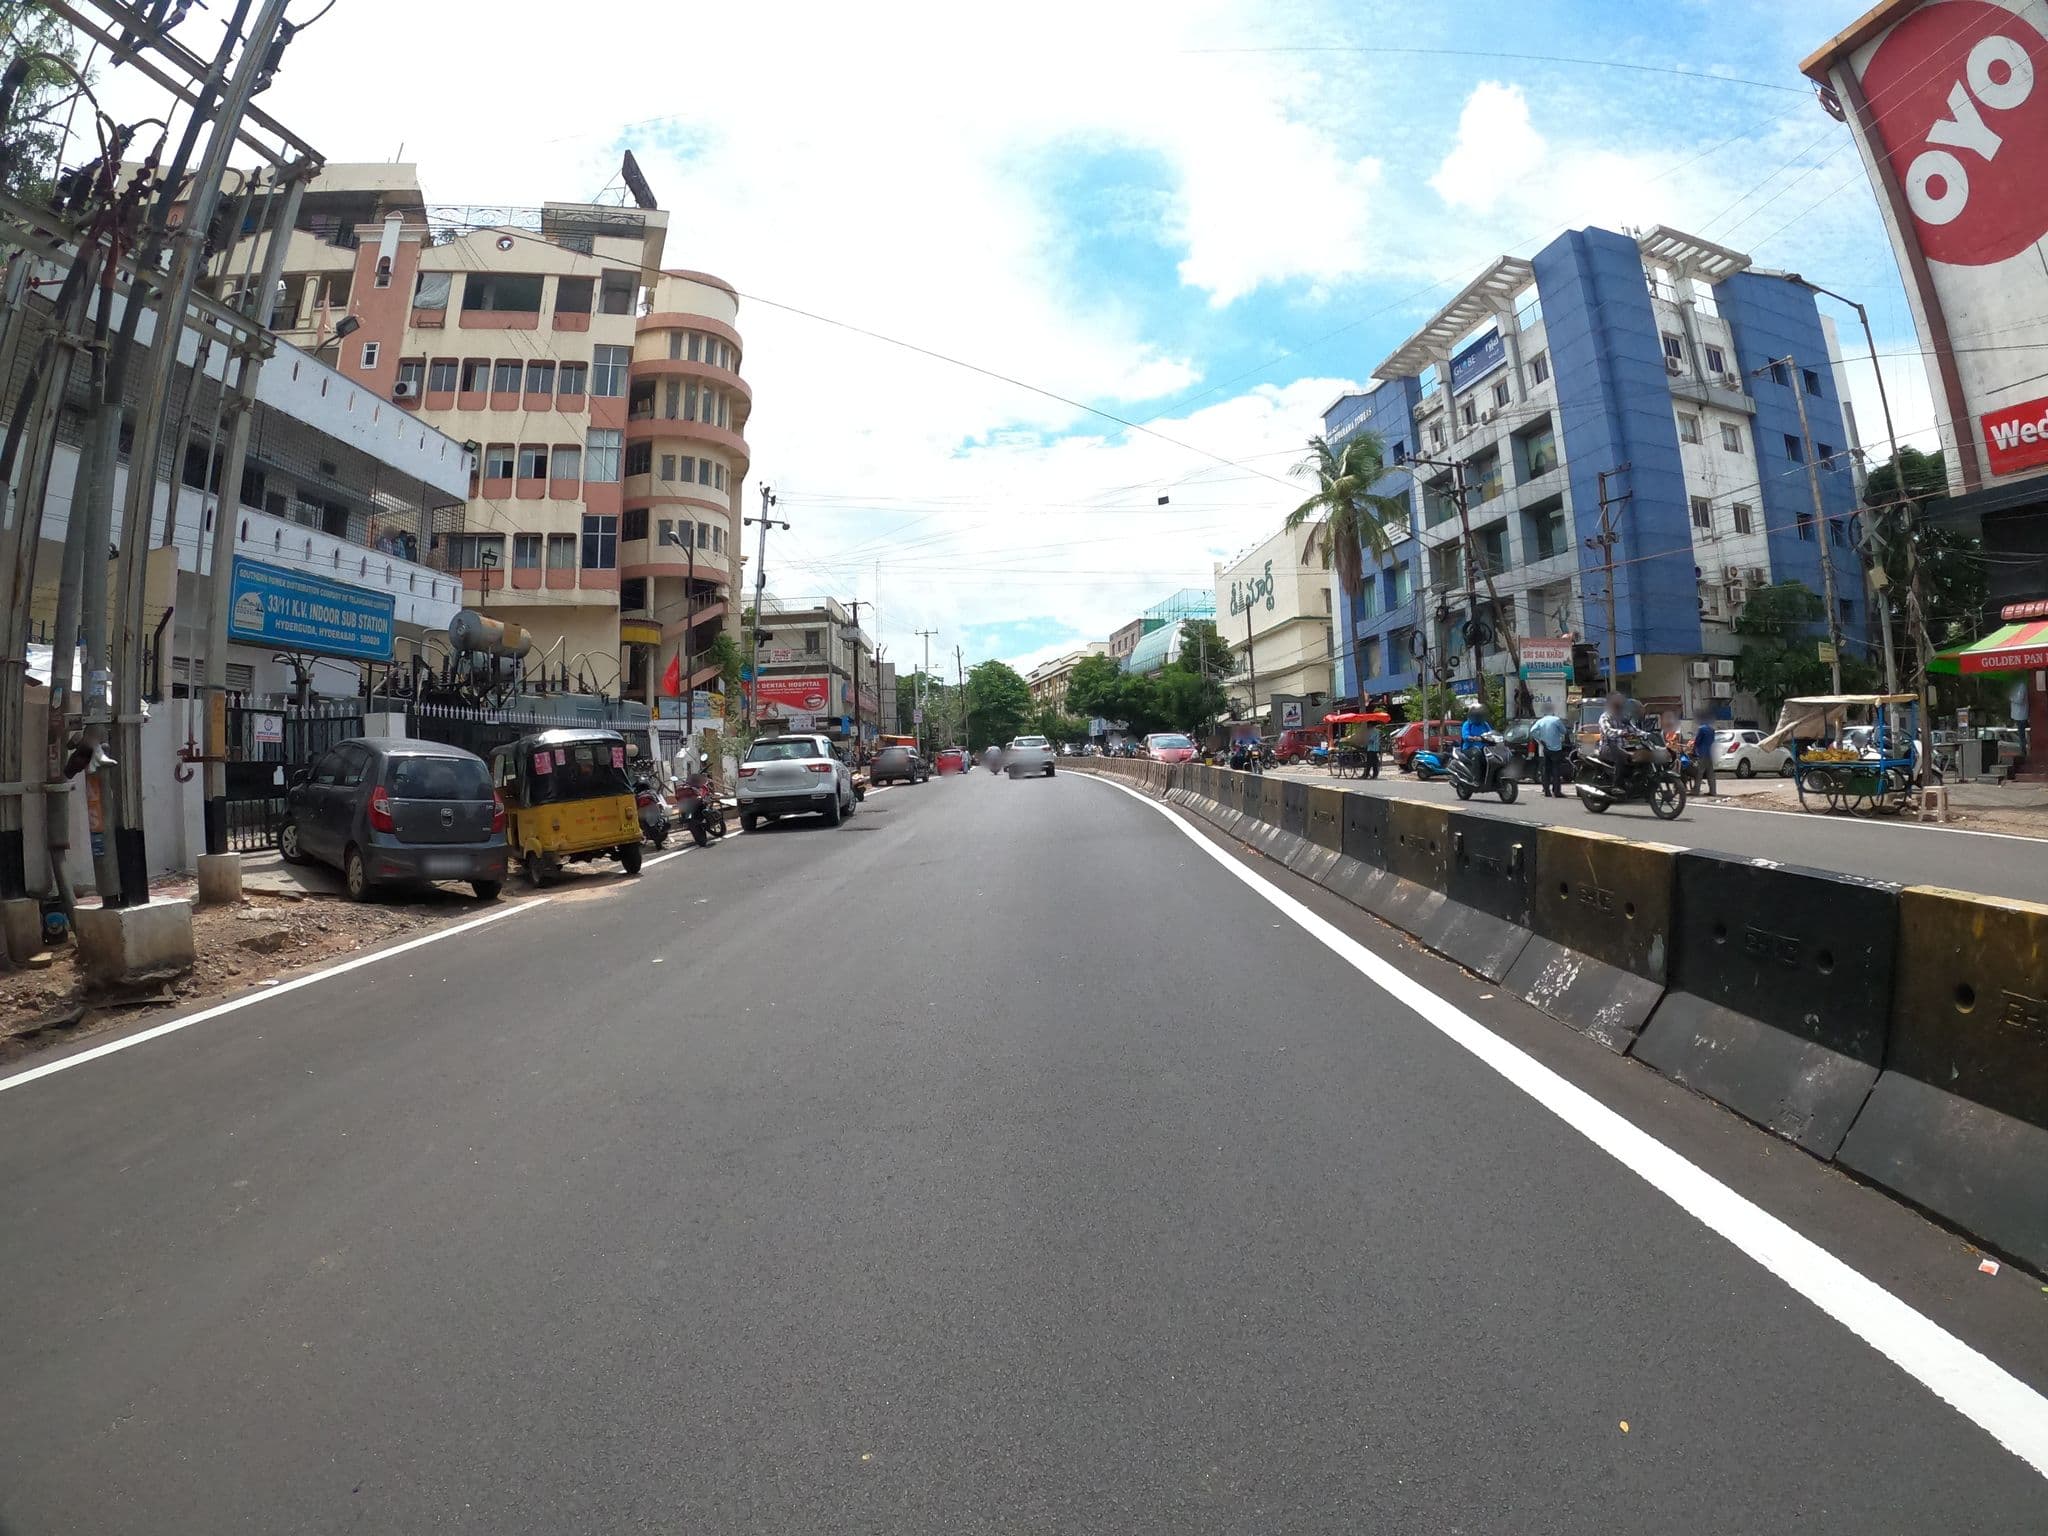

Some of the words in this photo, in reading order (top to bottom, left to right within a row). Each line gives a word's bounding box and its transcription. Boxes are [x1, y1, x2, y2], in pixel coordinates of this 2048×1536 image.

[1905, 35, 2034, 225] OYO
[267, 594, 290, 616] 33/11
[309, 603, 340, 626] INDOOR
[341, 610, 357, 628] SUB
[358, 614, 388, 634] STATION
[318, 627, 356, 641] HYDERABAD
[1981, 655, 2021, 668] GOLDEN
[2024, 652, 2043, 664] PAN
